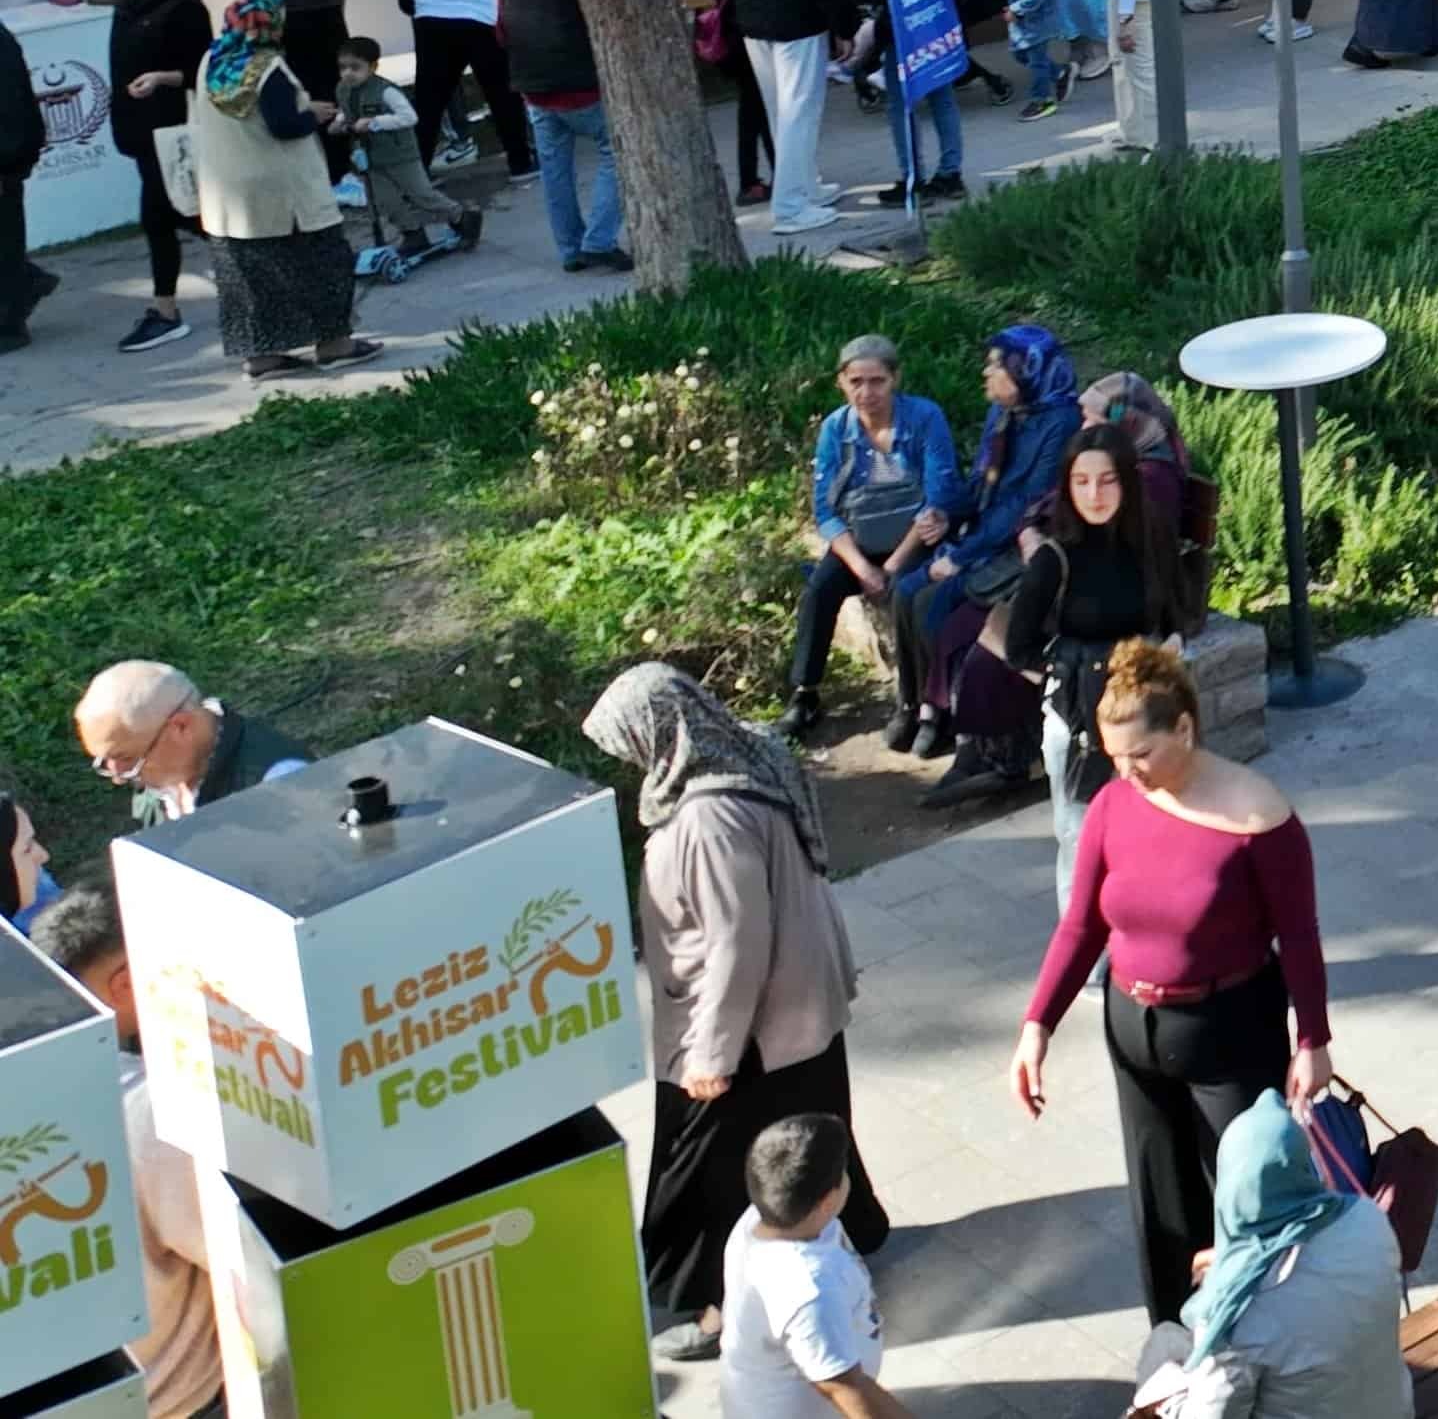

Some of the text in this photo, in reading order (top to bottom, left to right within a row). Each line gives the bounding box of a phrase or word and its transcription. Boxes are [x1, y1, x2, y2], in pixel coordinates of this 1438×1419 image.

[339, 979, 518, 1087] Akhisar
[361, 944, 489, 1026] Leziz
[378, 979, 622, 1129] Festivali
